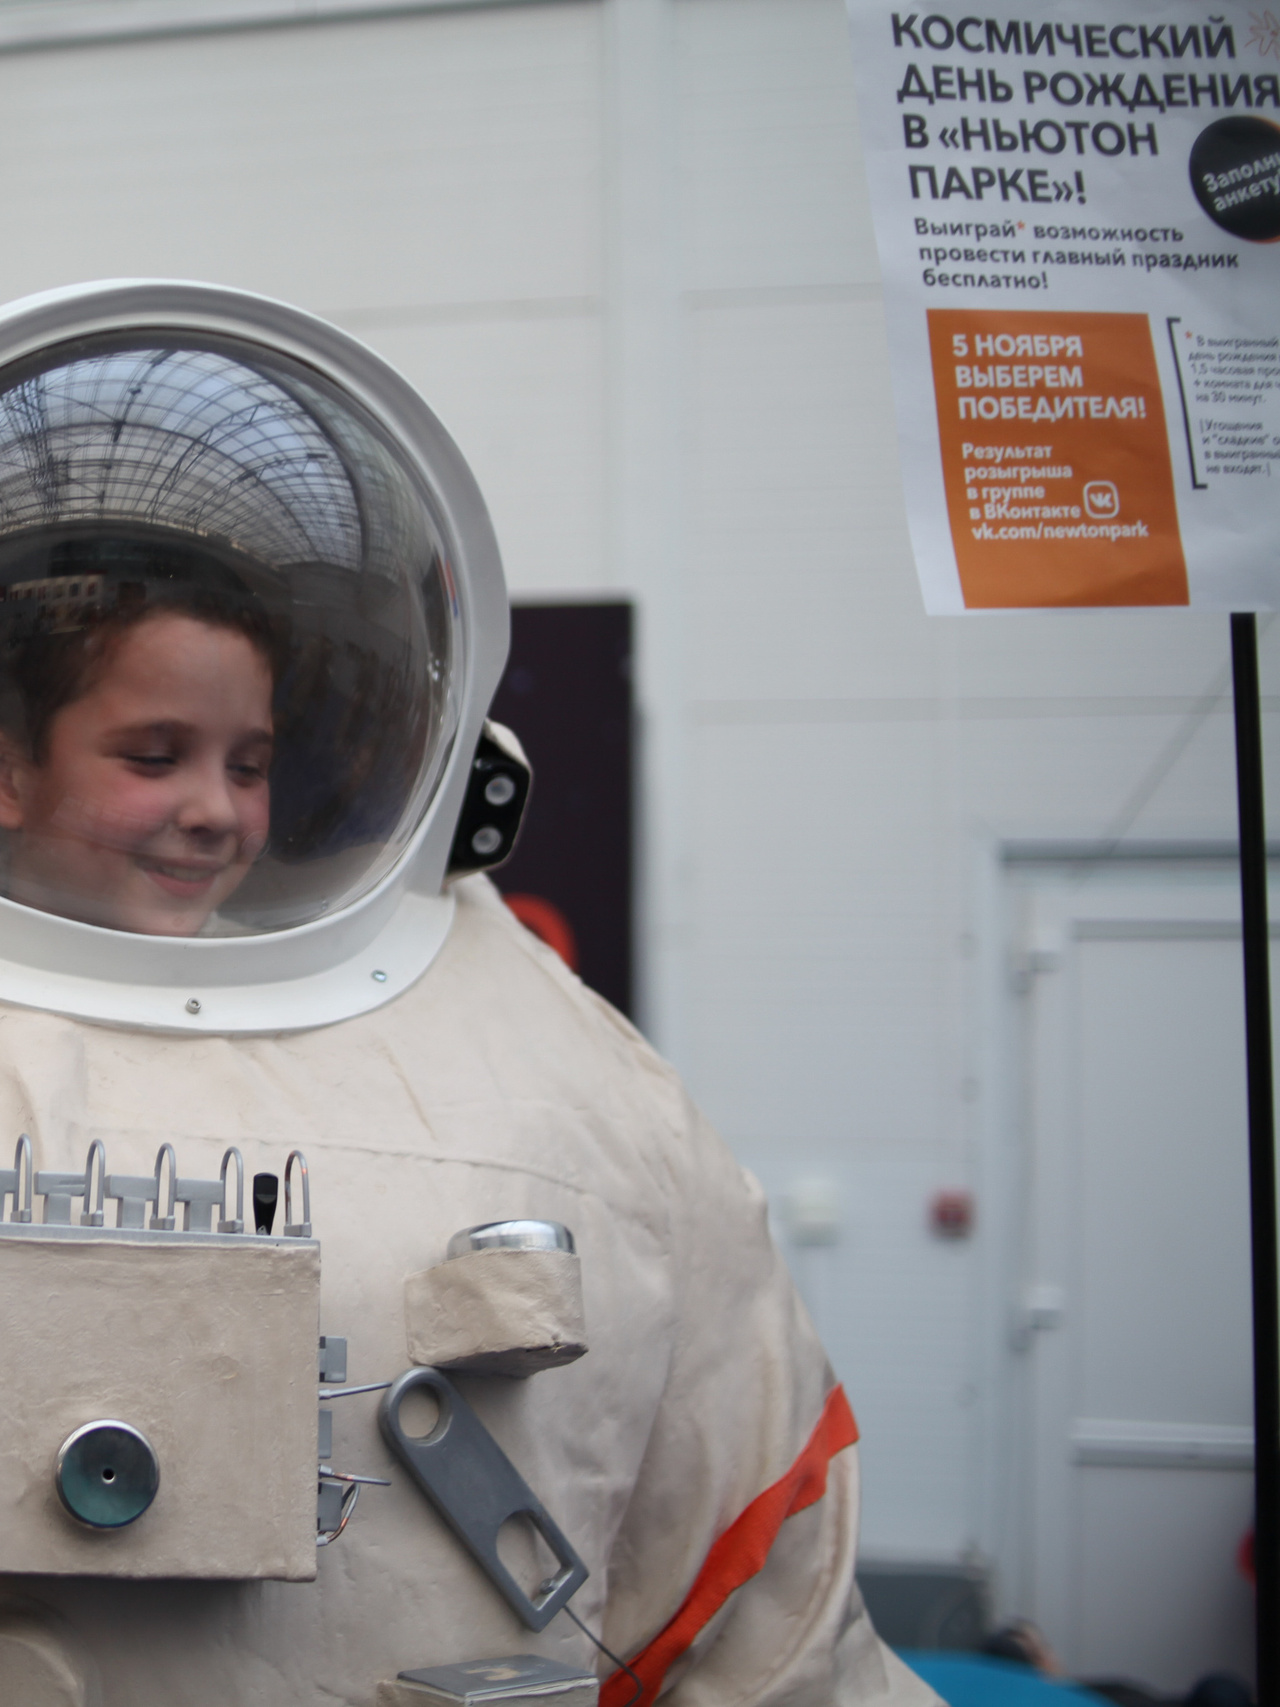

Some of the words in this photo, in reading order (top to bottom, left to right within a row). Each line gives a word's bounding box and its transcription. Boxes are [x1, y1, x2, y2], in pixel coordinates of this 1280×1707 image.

[891, 13, 1236, 59] КОСМИЧЕСКИЙ
[897, 64, 1013, 105] ДЕНЬ
[1024, 70, 1280, 113] РОЖДЕНИЯ
[903, 114, 929, 148] В
[938, 117, 1159, 156] «НЬЮТОН
[909, 165, 1086, 204] ПАРКЕ»!
[1034, 223, 1184, 242] возможность
[919, 246, 1025, 265] провести
[1032, 247, 1125, 267] главный
[1132, 253, 1239, 272] праздник
[923, 268, 1049, 289] бесплатно!
[952, 334, 969, 357] 5
[975, 334, 1083, 357] НОЯБРЯ
[956, 366, 1083, 388] ВЫБЕРЕМ
[958, 397, 1147, 423] ПОБЕДИТЕЛЯ!
[962, 443, 1052, 462] Результат
[964, 465, 1073, 484] розыгрыша
[967, 487, 978, 499] в
[982, 486, 1045, 504] группе
[970, 507, 980, 519] в
[985, 504, 1081, 519] ВКонтакте
[972, 521, 1149, 541] vk.com/newtonpark
